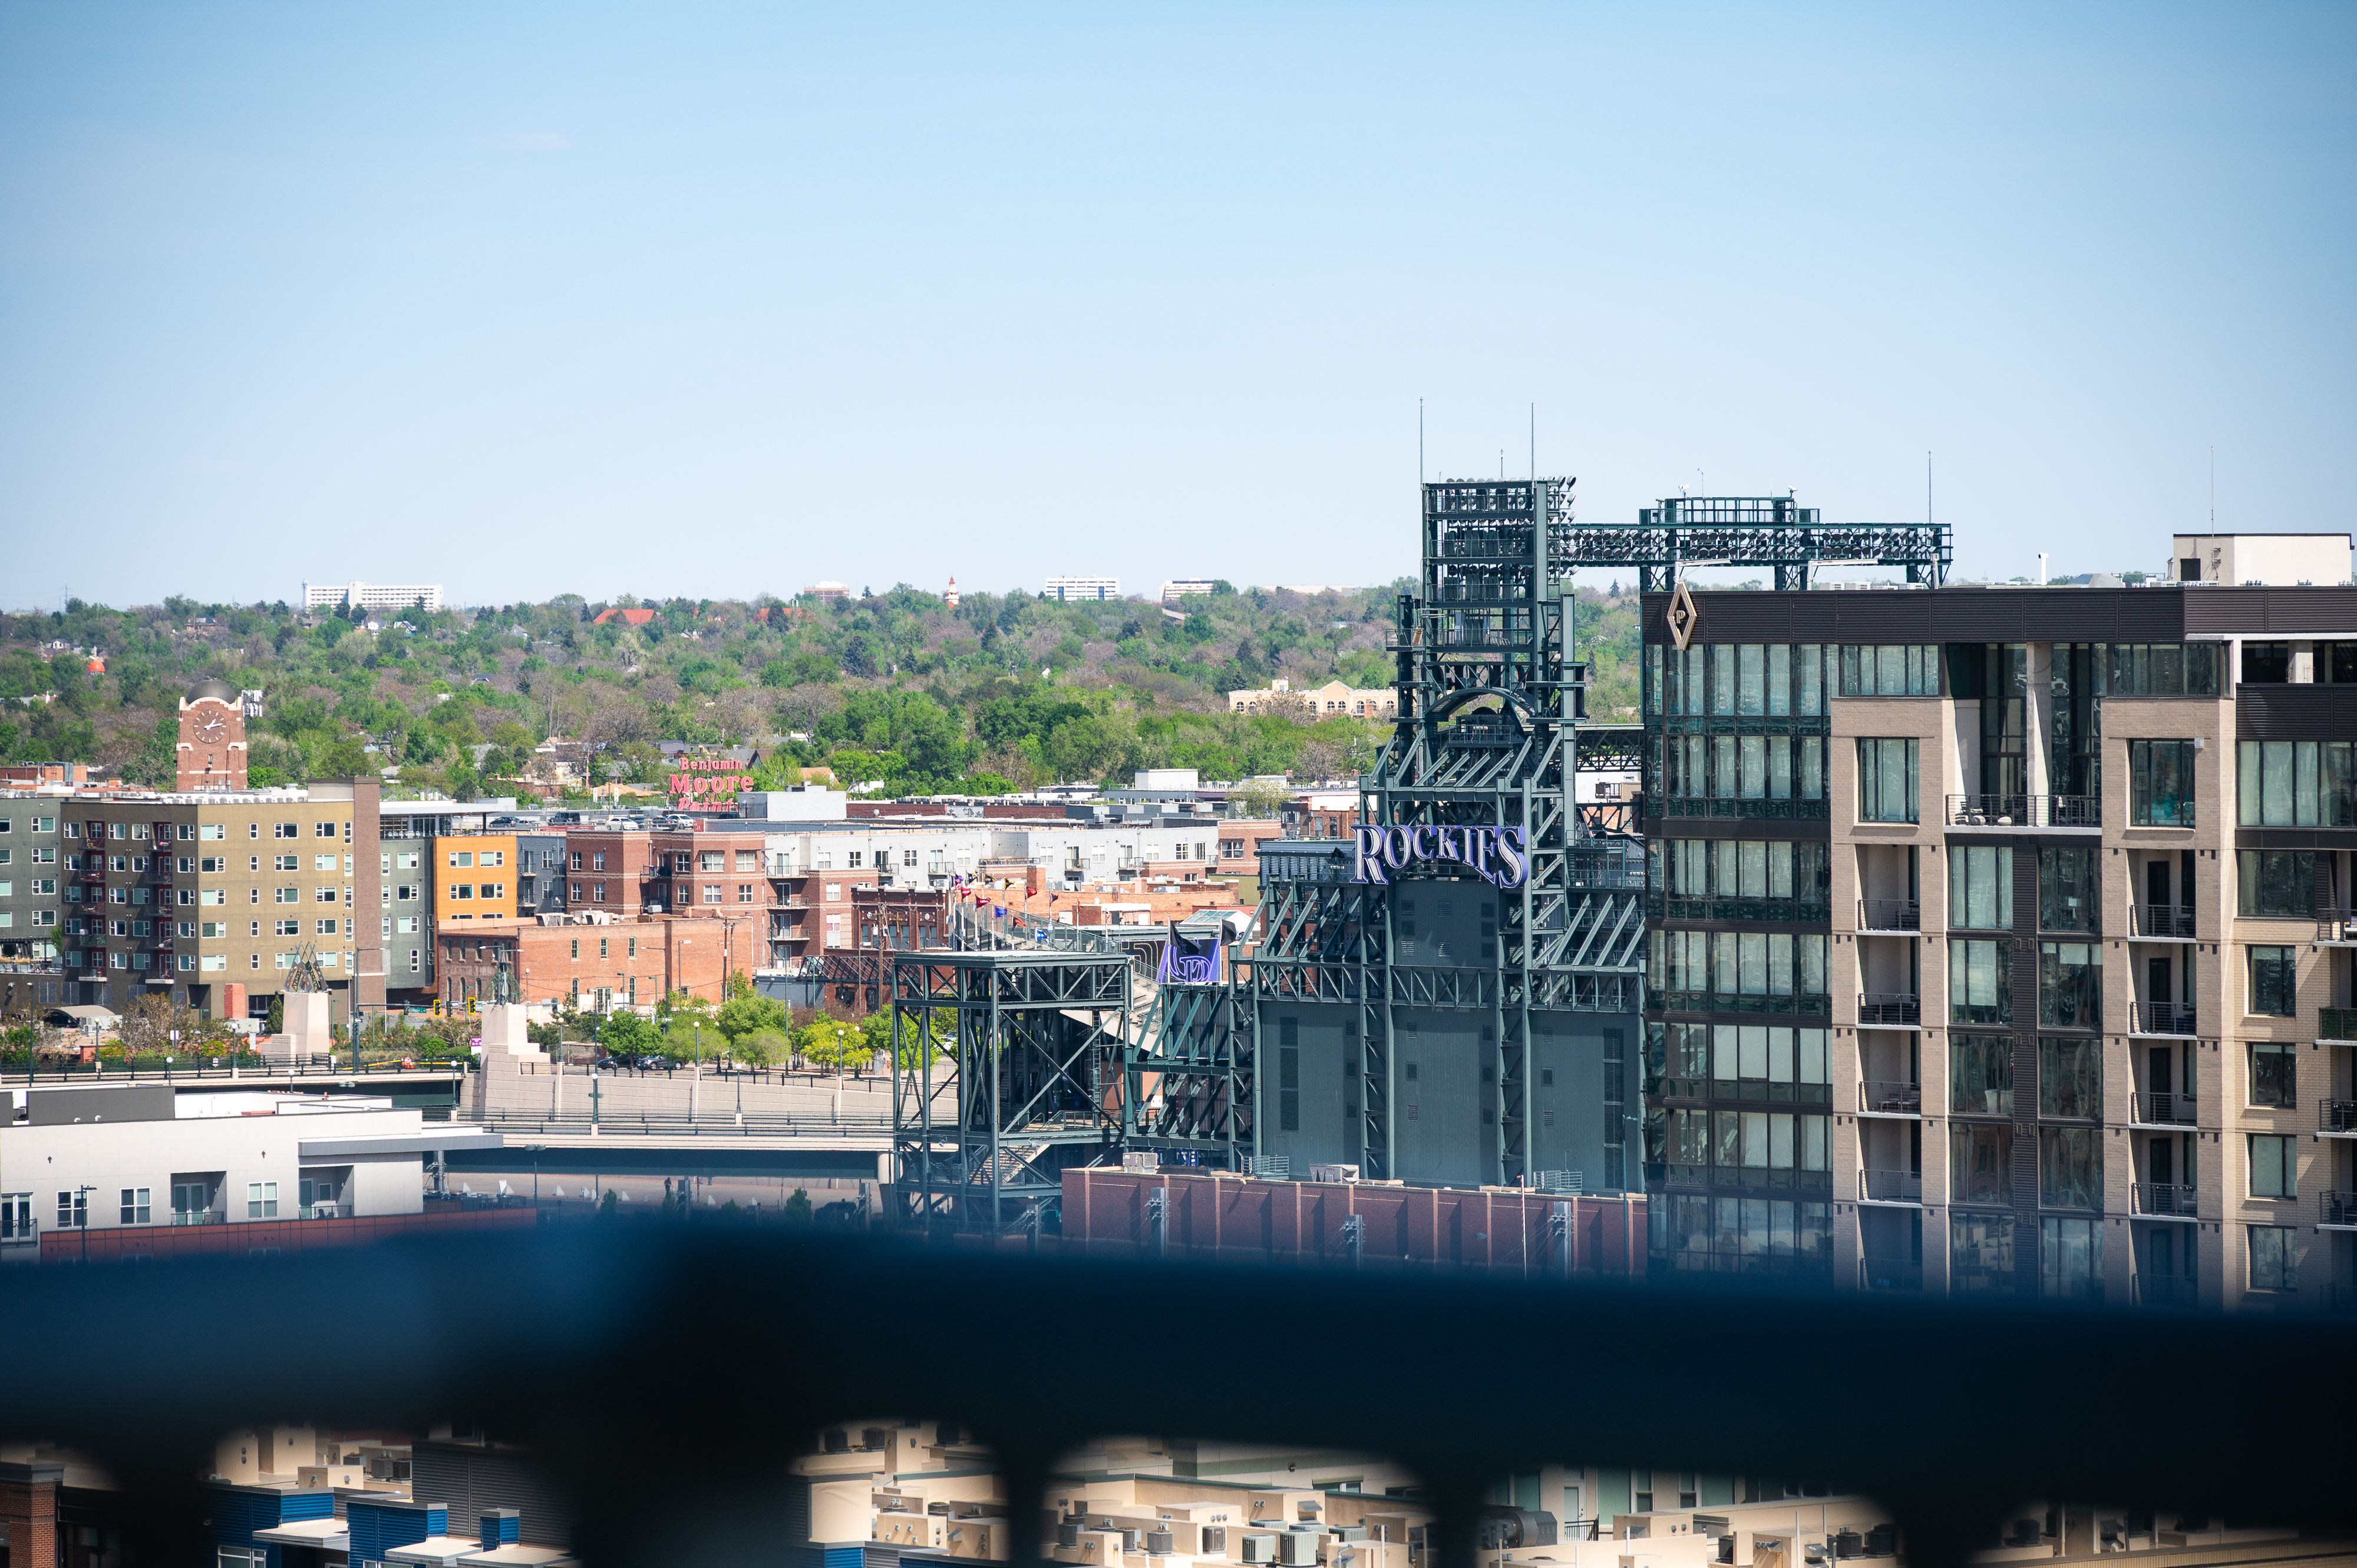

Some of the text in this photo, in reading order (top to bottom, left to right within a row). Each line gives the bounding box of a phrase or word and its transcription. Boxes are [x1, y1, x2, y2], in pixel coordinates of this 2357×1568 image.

[1676, 610, 1686, 624] P
[680, 756, 742, 772] Benjamin
[669, 774, 754, 794] Moore
[1349, 824, 1529, 889] ROCKIES
